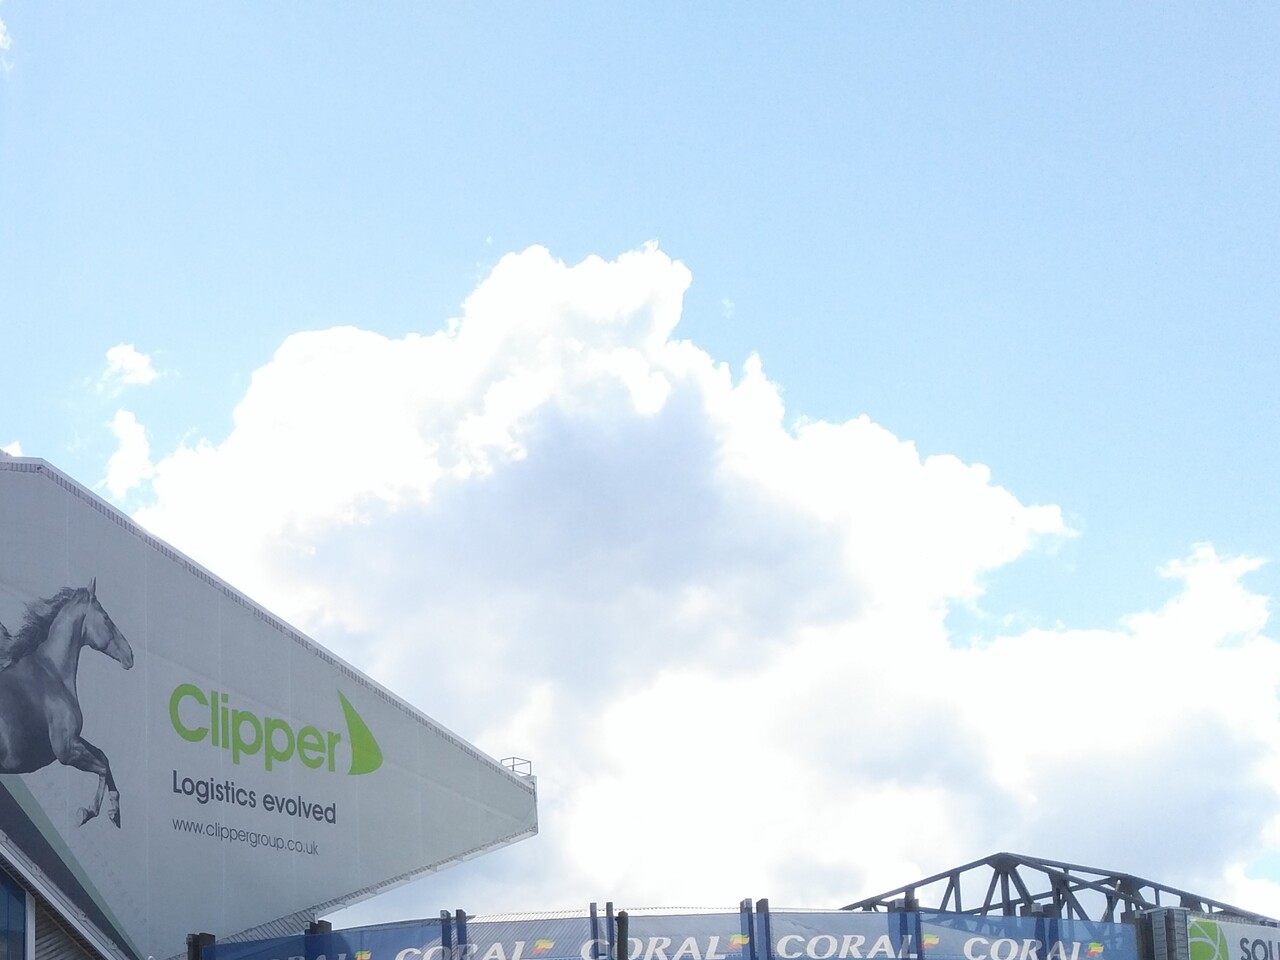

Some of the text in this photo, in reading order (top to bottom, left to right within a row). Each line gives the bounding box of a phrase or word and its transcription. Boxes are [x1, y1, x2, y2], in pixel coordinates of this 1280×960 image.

[168, 683, 341, 773] Clipper
[172, 770, 337, 825] Logistics evolved
[172, 817, 319, 856] www.clippergroup.co.uk
[776, 934, 919, 960] CORAL
